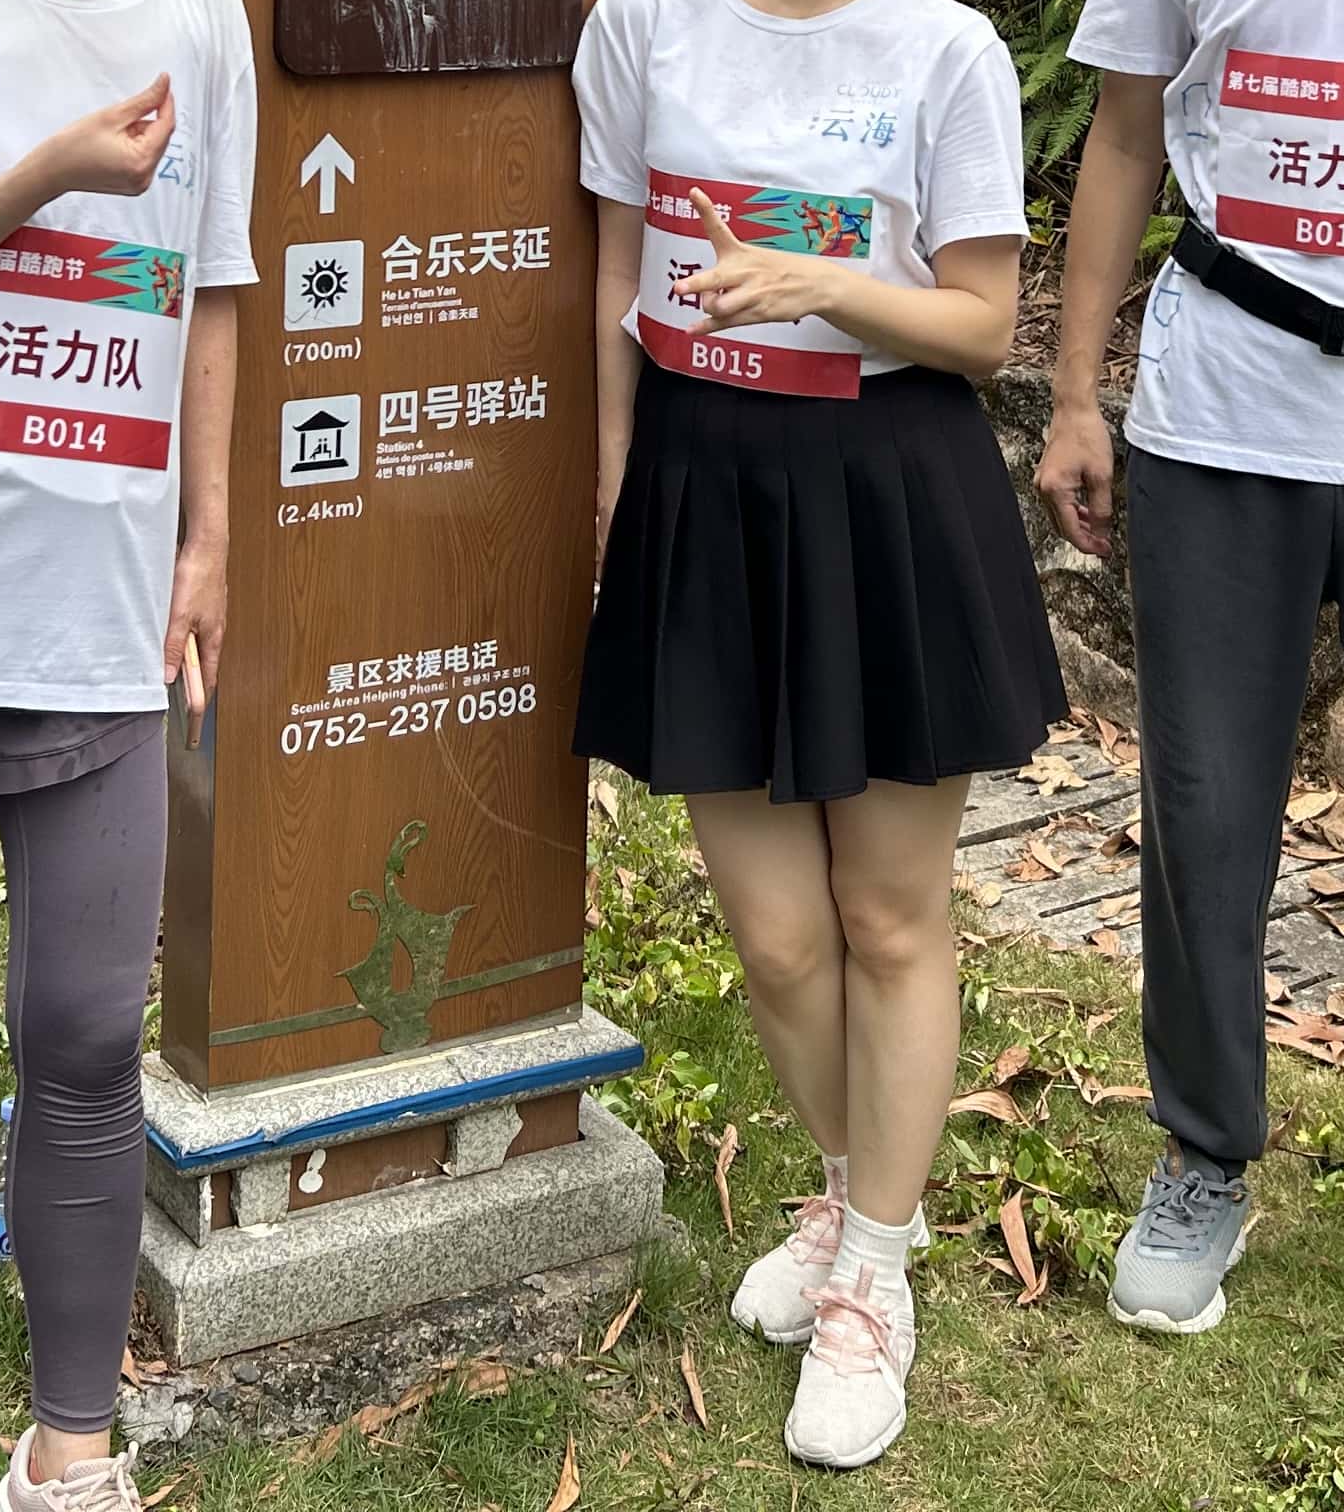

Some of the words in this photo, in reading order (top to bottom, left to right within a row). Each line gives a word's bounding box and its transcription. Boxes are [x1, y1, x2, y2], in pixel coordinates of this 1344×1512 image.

[1228, 69, 1341, 104] 第七届酷跑节
[821, 111, 898, 149] 云海
[647, 189, 732, 222] 七届酷节
[381, 226, 551, 282] 合乐天延
[381, 290, 396, 301] He
[398, 289, 410, 300] Le
[412, 287, 434, 298] Tian
[283, 337, 362, 366] (700m)
[691, 342, 763, 379] B015
[378, 375, 548, 437] 四号驿站
[22, 415, 107, 453] B014
[376, 442, 415, 454] Station
[416, 439, 424, 449] 4
[277, 496, 363, 527] (2.4km)
[327, 639, 498, 694] 景区求援电话
[280, 699, 450, 754] 0752-237
[457, 684, 536, 725] 0598
[291, 700, 330, 716] Scenic
[333, 695, 359, 709] Area
[363, 687, 406, 705] Helping
